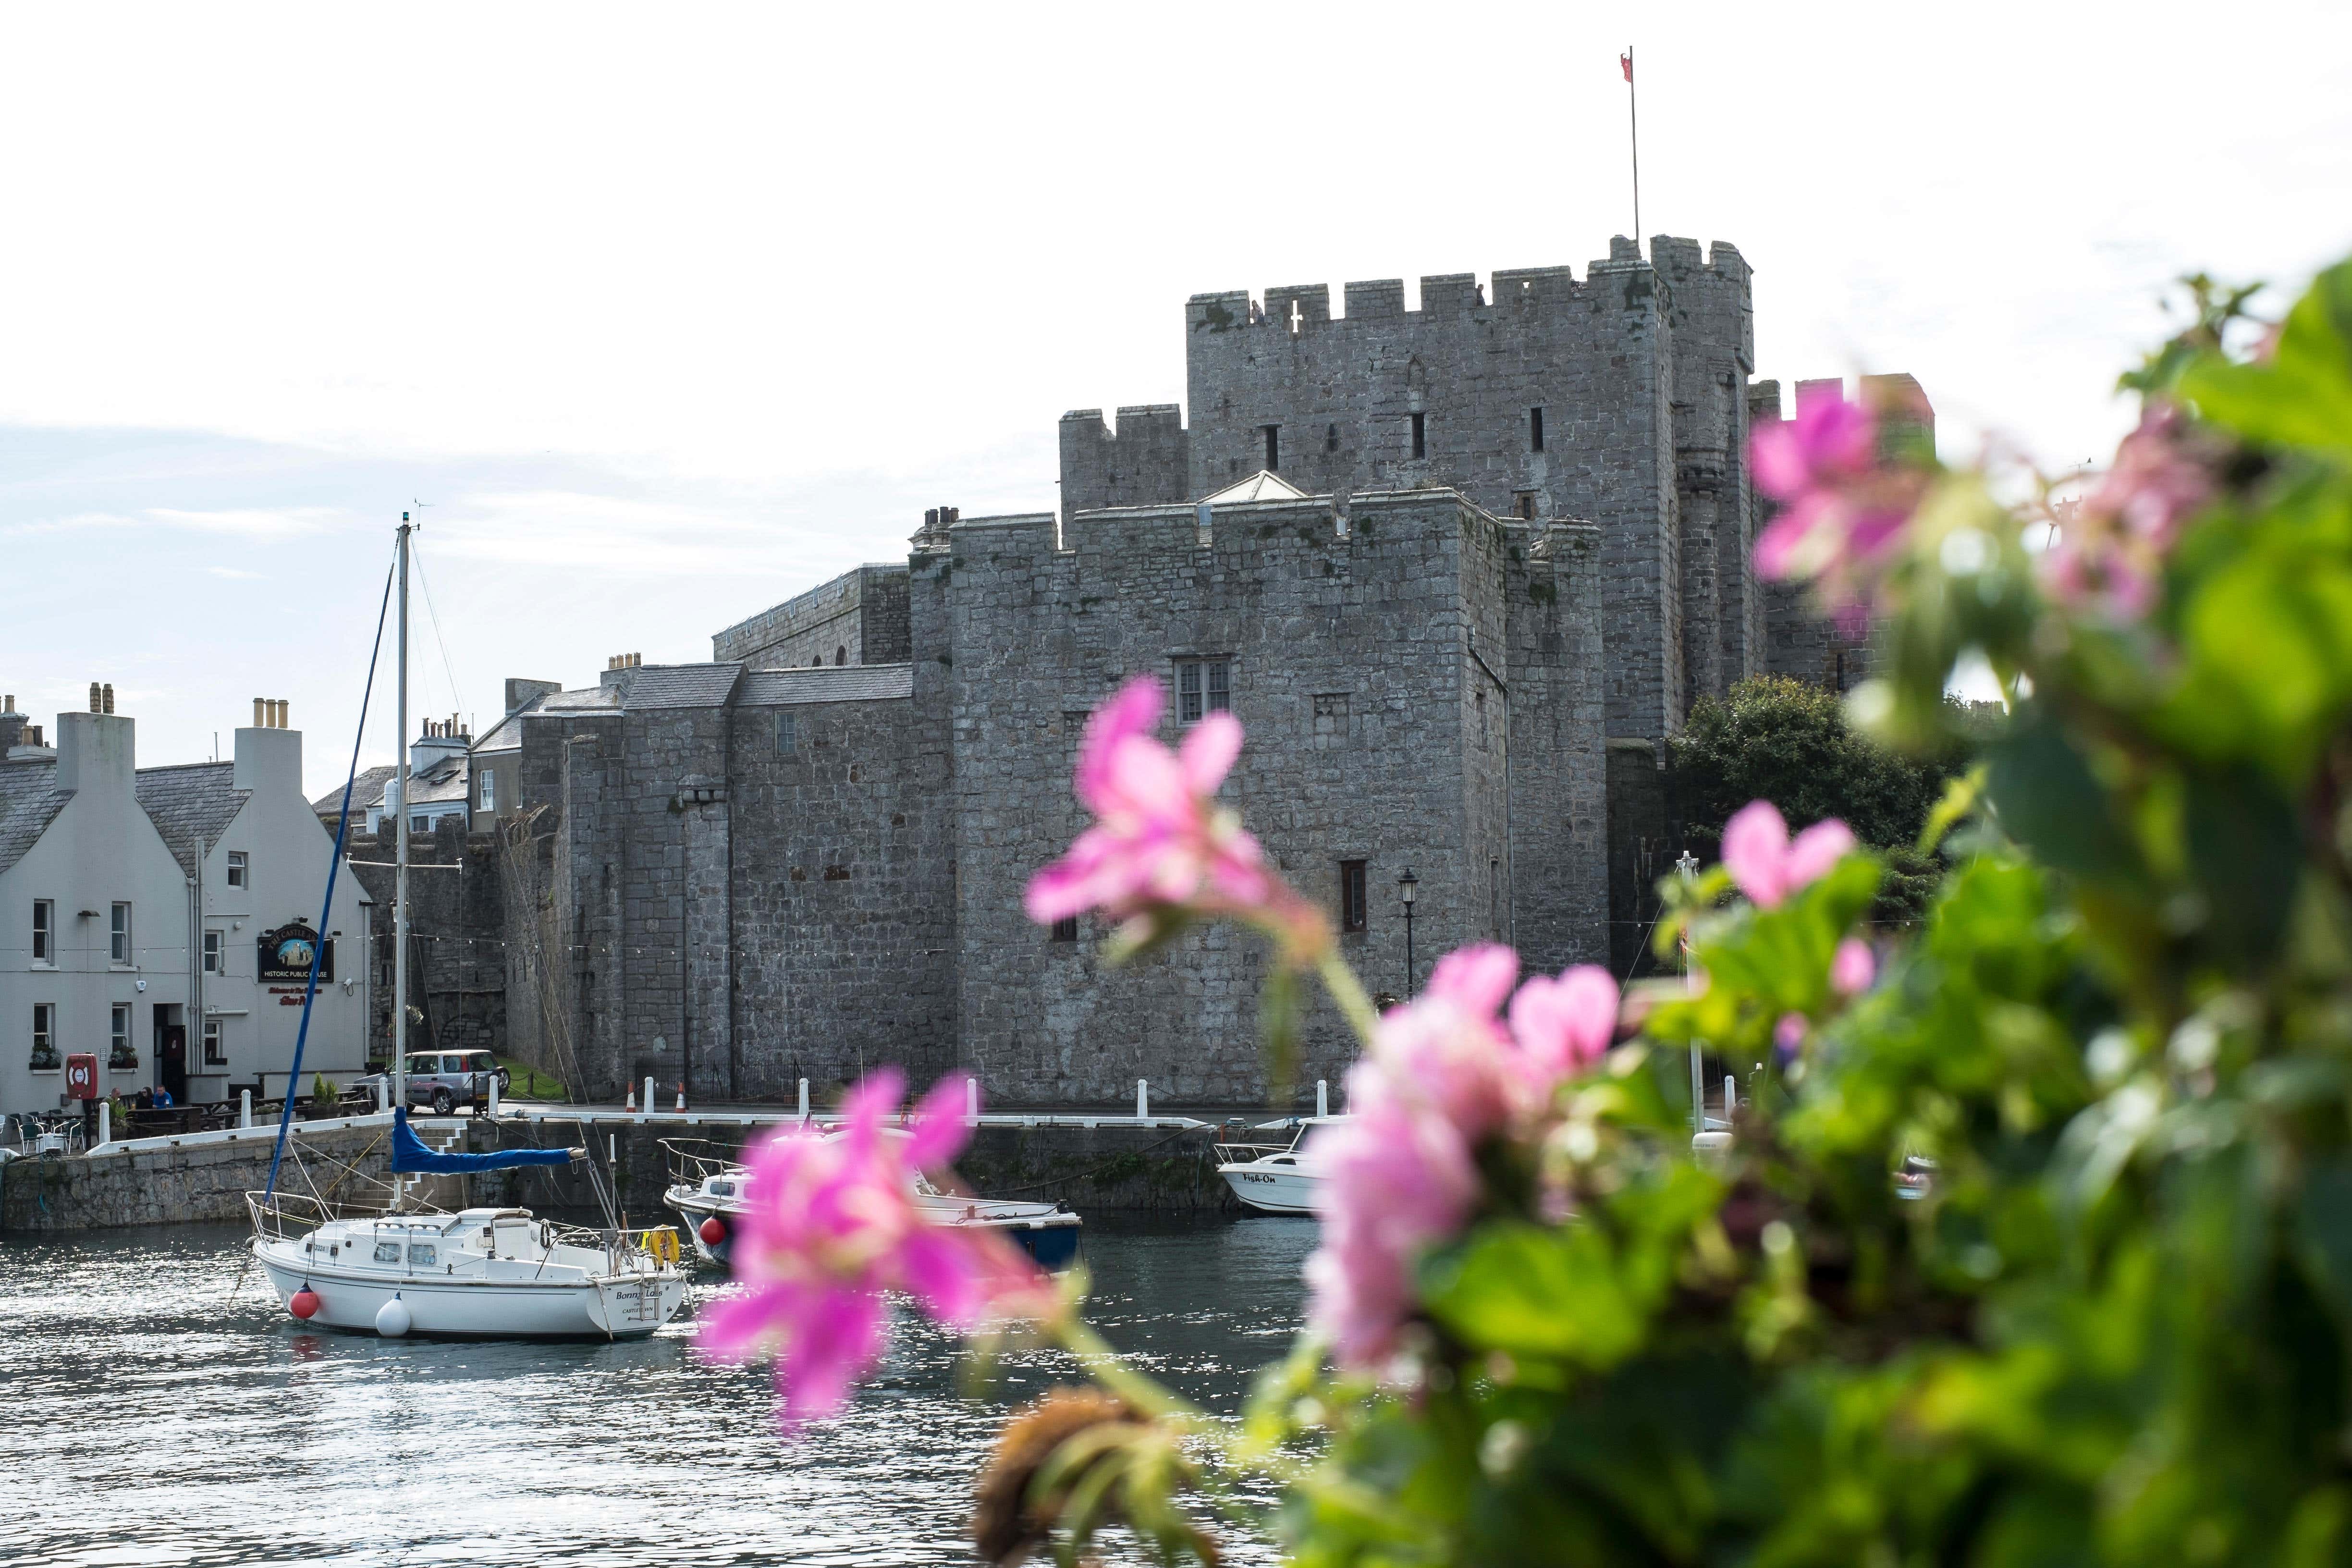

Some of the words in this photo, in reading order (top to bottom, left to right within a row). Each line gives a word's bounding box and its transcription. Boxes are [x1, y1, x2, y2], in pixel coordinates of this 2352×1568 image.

[269, 935, 281, 949] THE
[282, 929, 305, 938] CASTLE
[1242, 1173, 1276, 1183] Fish-On
